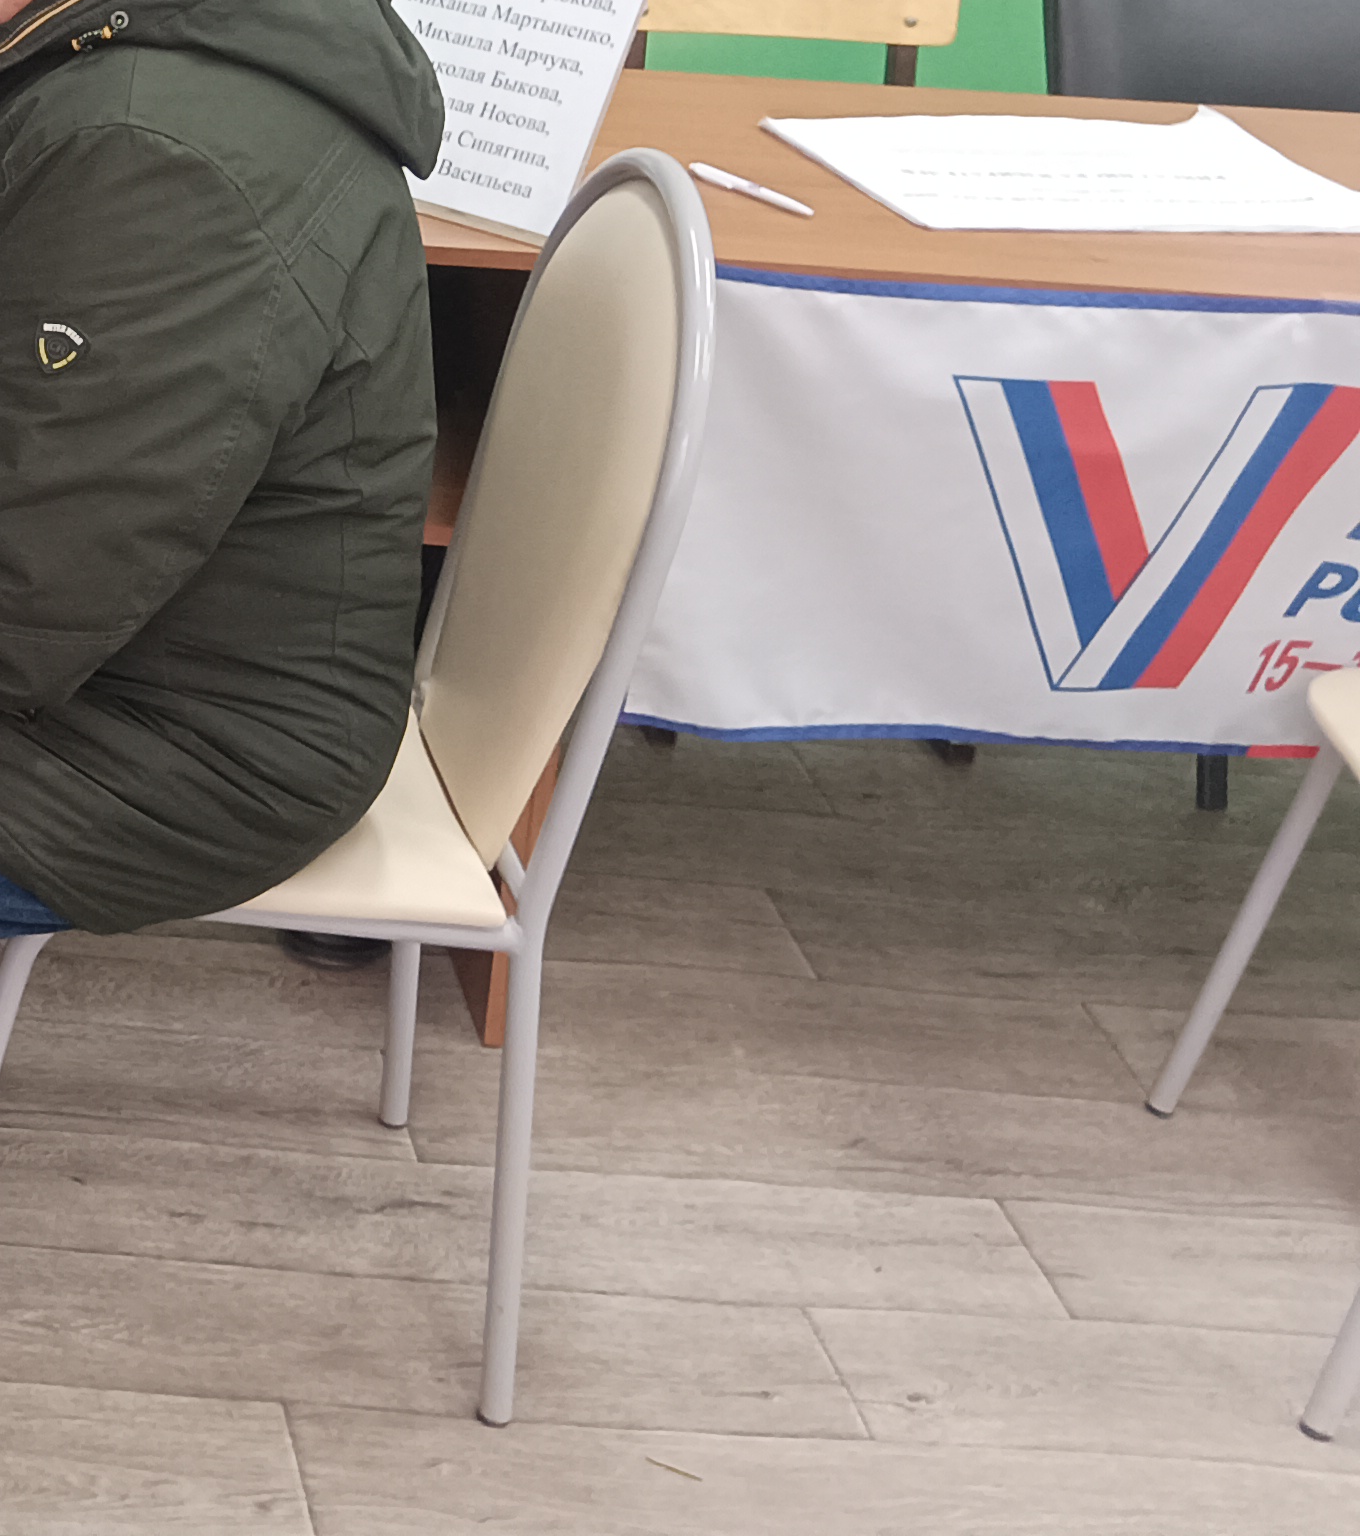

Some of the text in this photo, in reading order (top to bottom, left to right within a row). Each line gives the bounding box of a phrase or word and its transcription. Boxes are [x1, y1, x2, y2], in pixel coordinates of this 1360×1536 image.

[491, 4, 615, 49] Мартыненко,
[414, 19, 584, 76] Михаила Марчука,
[491, 70, 562, 105] Быкова,
[479, 101, 549, 136] Носова,
[457, 129, 550, 170] Сипягина,
[437, 158, 532, 199] Васильева
